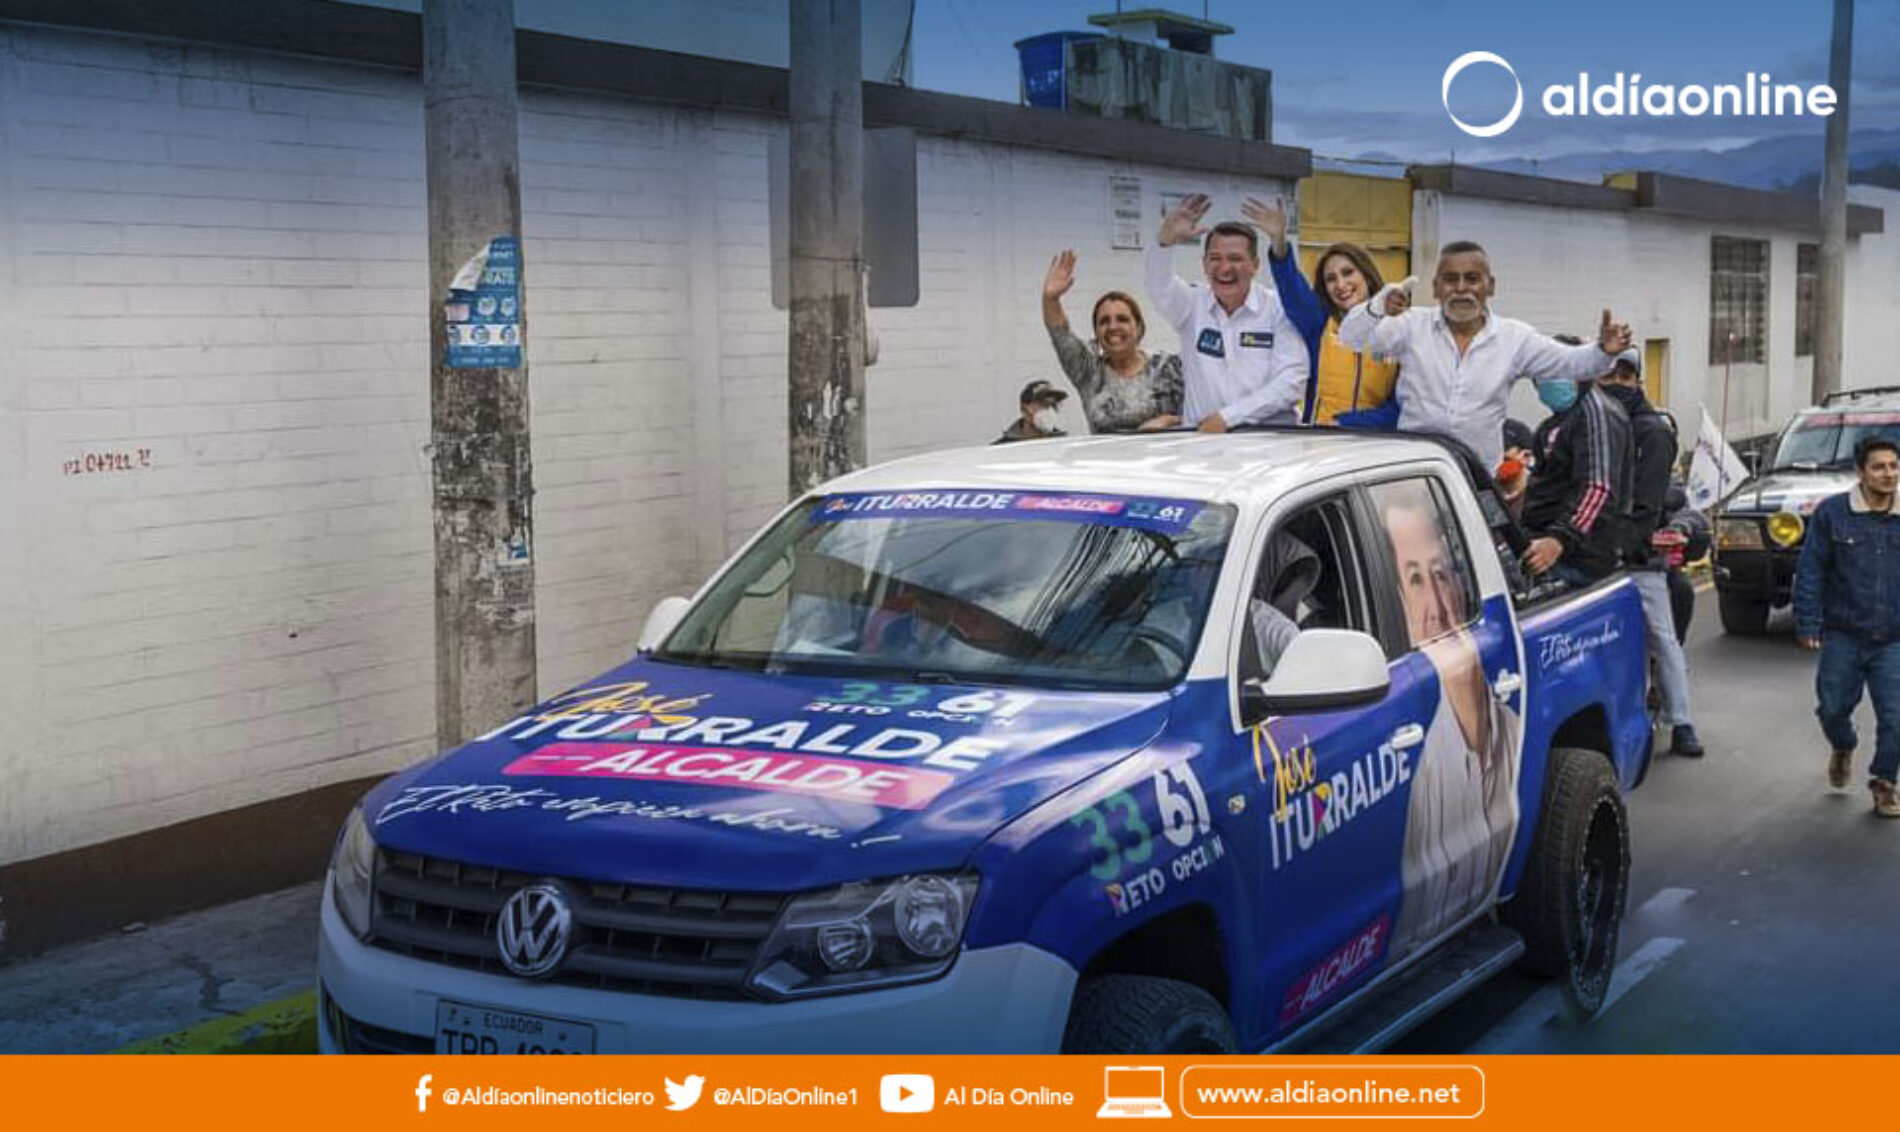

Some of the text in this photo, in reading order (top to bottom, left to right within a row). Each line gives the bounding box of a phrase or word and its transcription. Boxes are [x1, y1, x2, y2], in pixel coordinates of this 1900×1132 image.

[852, 493, 1014, 512] ITURRALDE
[474, 714, 1015, 771] ITURRALDE
[1252, 716, 1316, 823] José
[578, 749, 912, 799] ALCALDE
[1071, 759, 1211, 880] 33 61
[1269, 745, 1411, 871] ITURRALDE
[1105, 872, 1165, 917] RETO
[1300, 924, 1381, 1011] ALCALDE
[483, 1012, 543, 1035] ECUADOR
